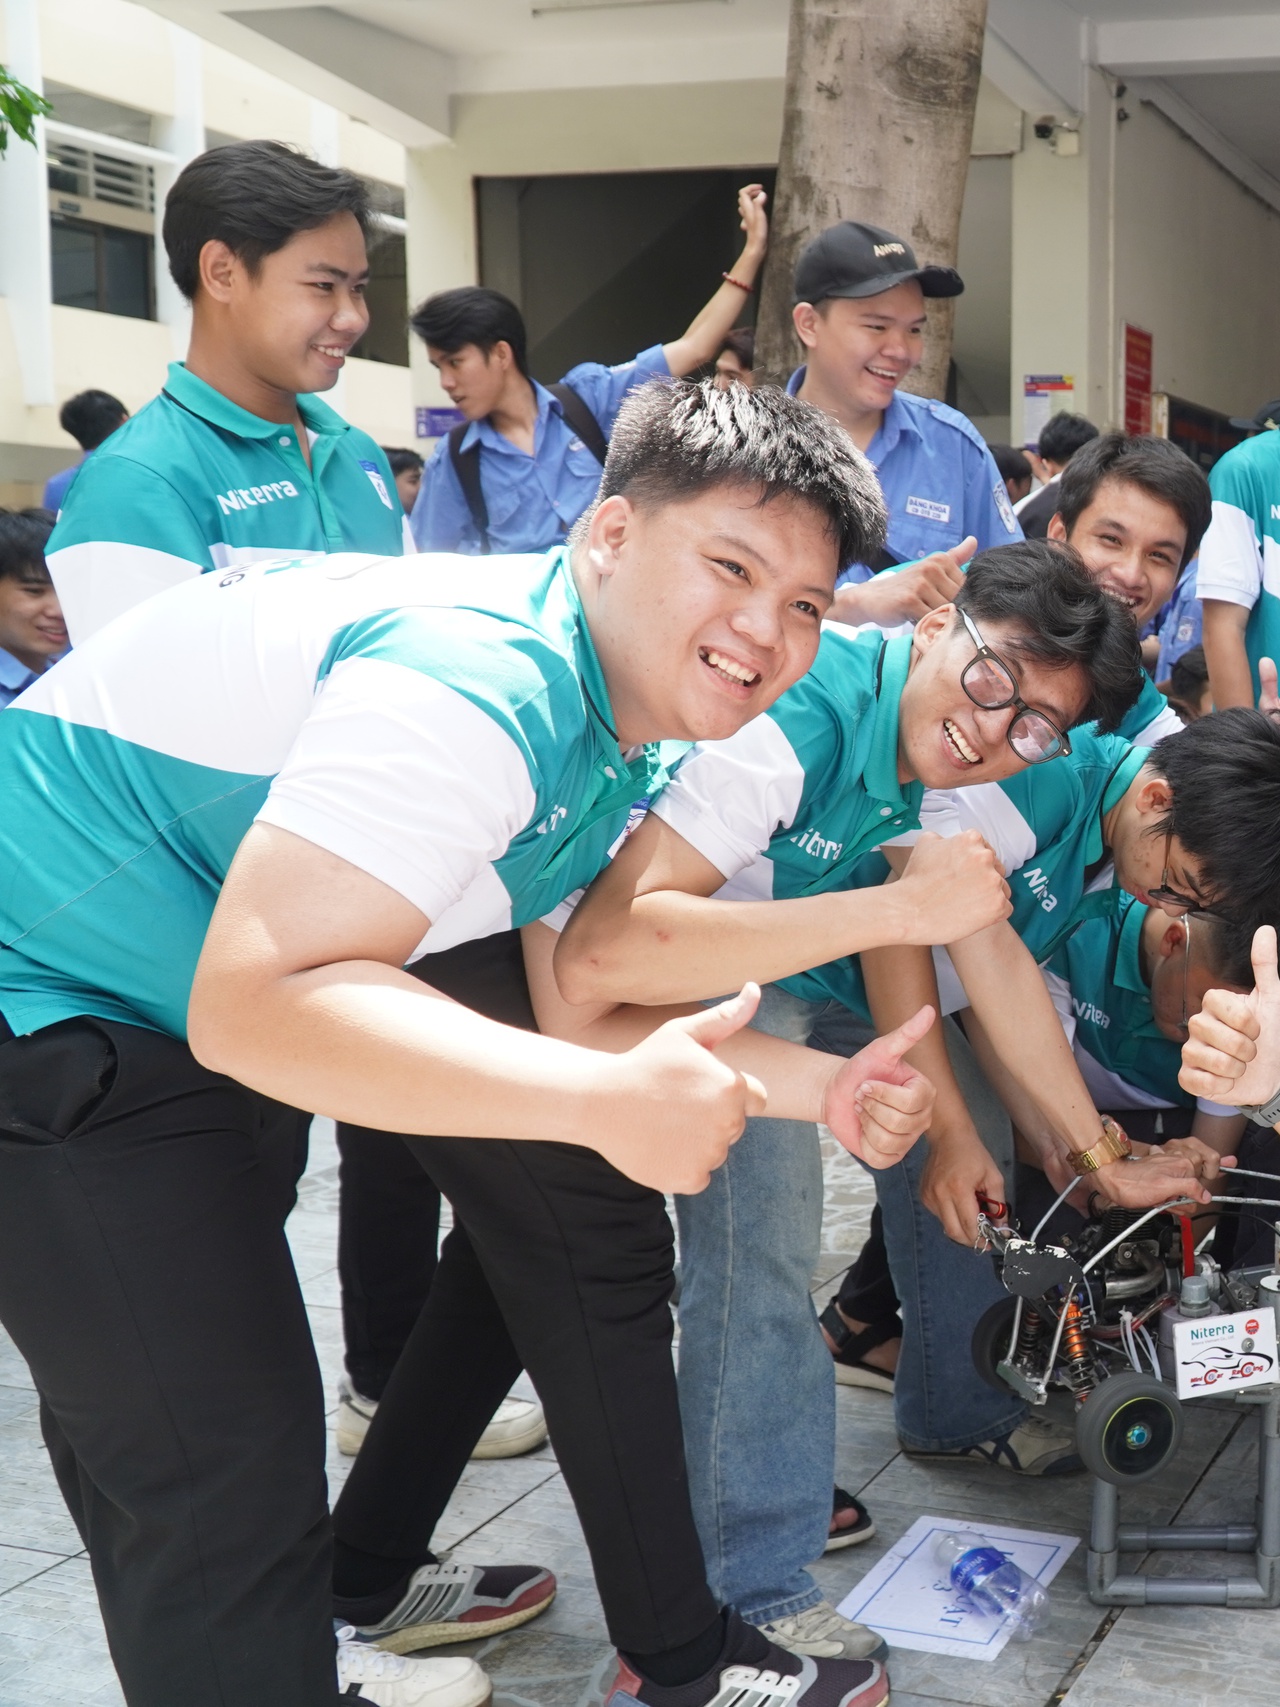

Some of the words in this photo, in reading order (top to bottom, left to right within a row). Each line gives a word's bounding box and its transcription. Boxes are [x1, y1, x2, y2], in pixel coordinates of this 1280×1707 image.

[216, 480, 299, 515] Niterra
[1190, 1324, 1235, 1340] Niterra
[954, 1555, 987, 1586] QUAFINA
